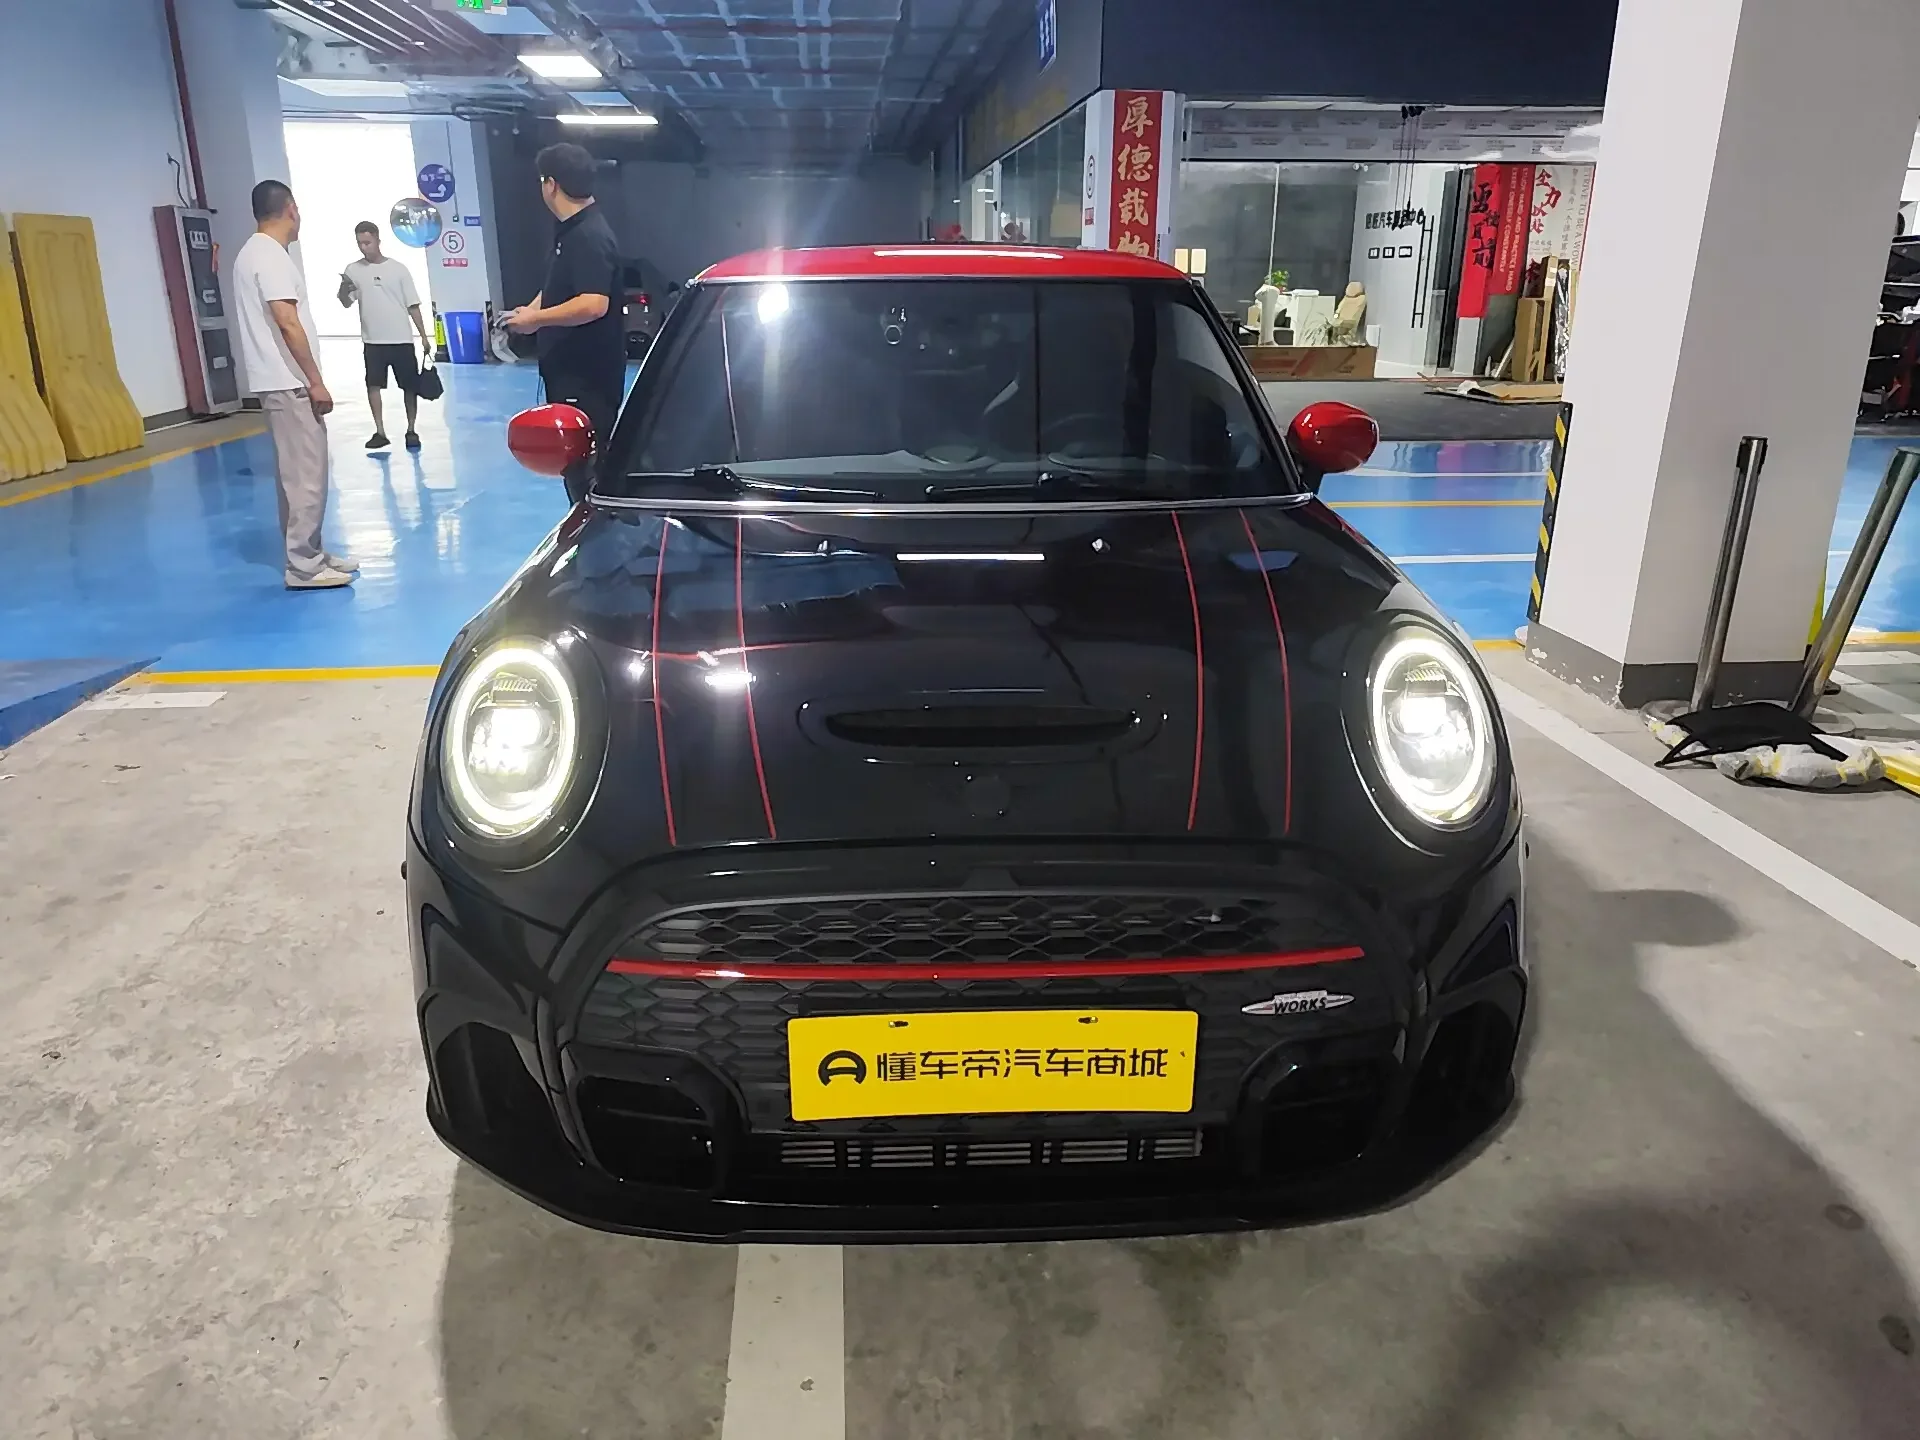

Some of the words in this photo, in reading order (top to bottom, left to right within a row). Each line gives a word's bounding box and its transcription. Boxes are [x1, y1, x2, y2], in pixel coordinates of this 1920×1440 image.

[1579, 202, 1587, 216] TO
[448, 234, 459, 250] 5
[1506, 270, 1514, 292] HARD
[1274, 997, 1327, 1014] WORKS
[876, 1047, 1169, 1082] 懂车帝汽车商城
